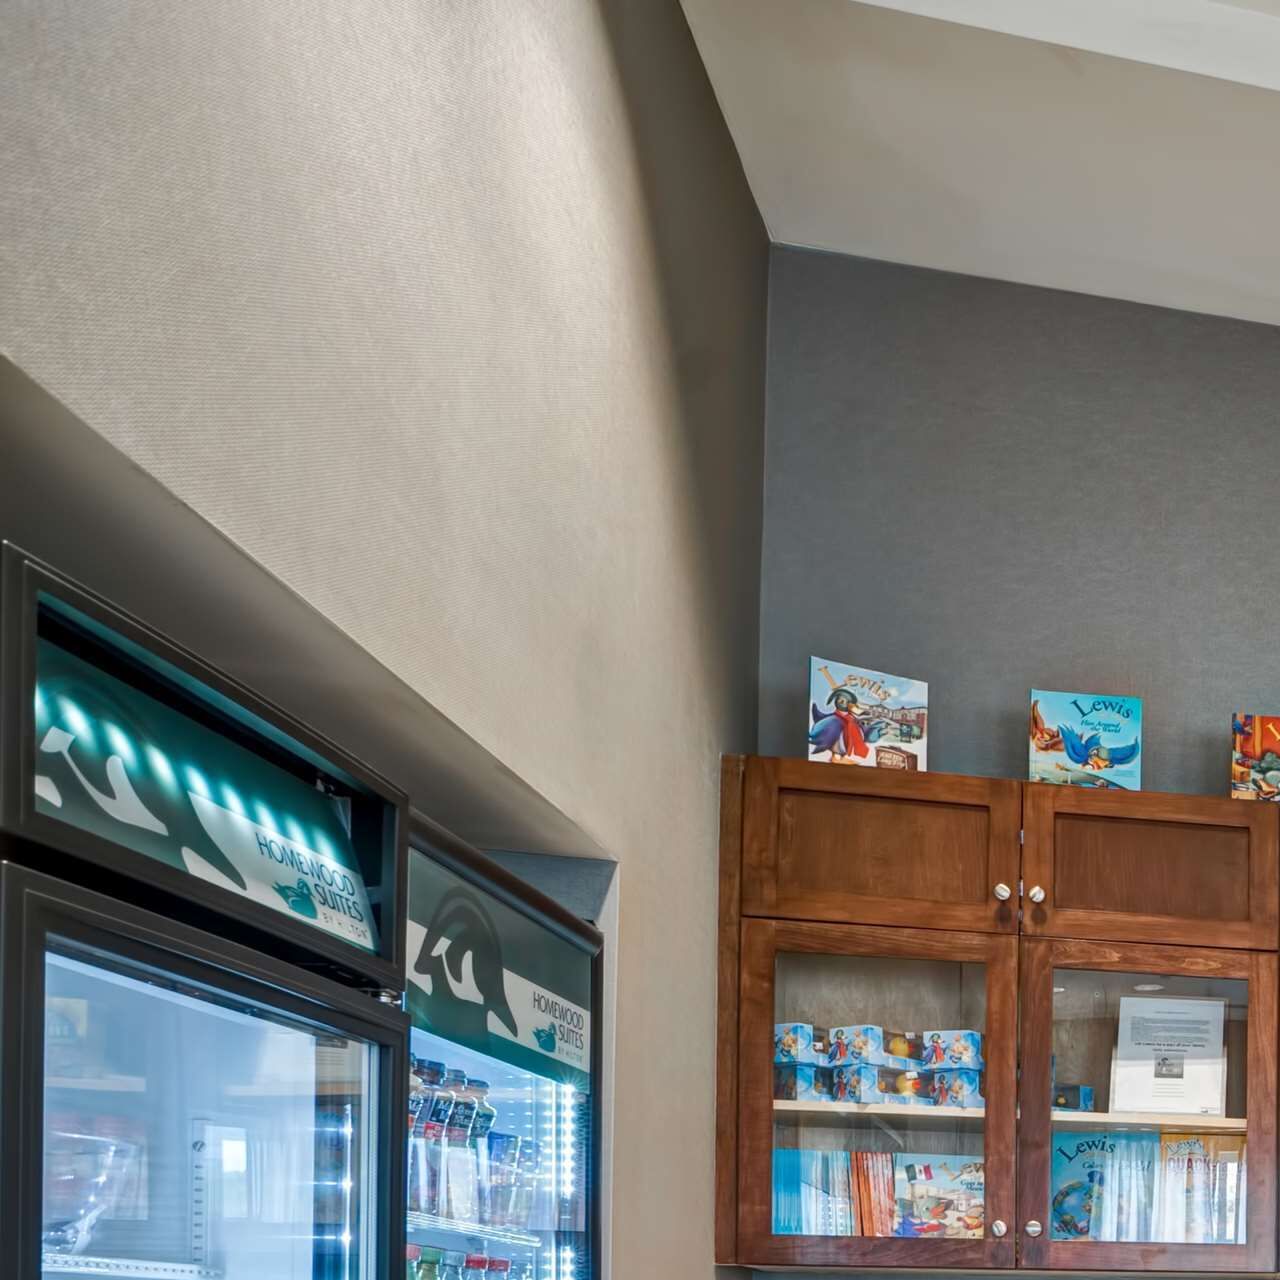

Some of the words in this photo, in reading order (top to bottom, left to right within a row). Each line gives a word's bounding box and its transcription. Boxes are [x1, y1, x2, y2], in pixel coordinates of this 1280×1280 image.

[818, 665, 891, 701] Lewis
[1070, 698, 1133, 719] Lewis
[255, 831, 356, 897] HOMEWOOD
[314, 883, 364, 922] SUITES
[533, 991, 584, 1031] HOMEWOOD
[558, 1024, 584, 1050] SUITES
[1056, 1136, 1116, 1163] Lewis
